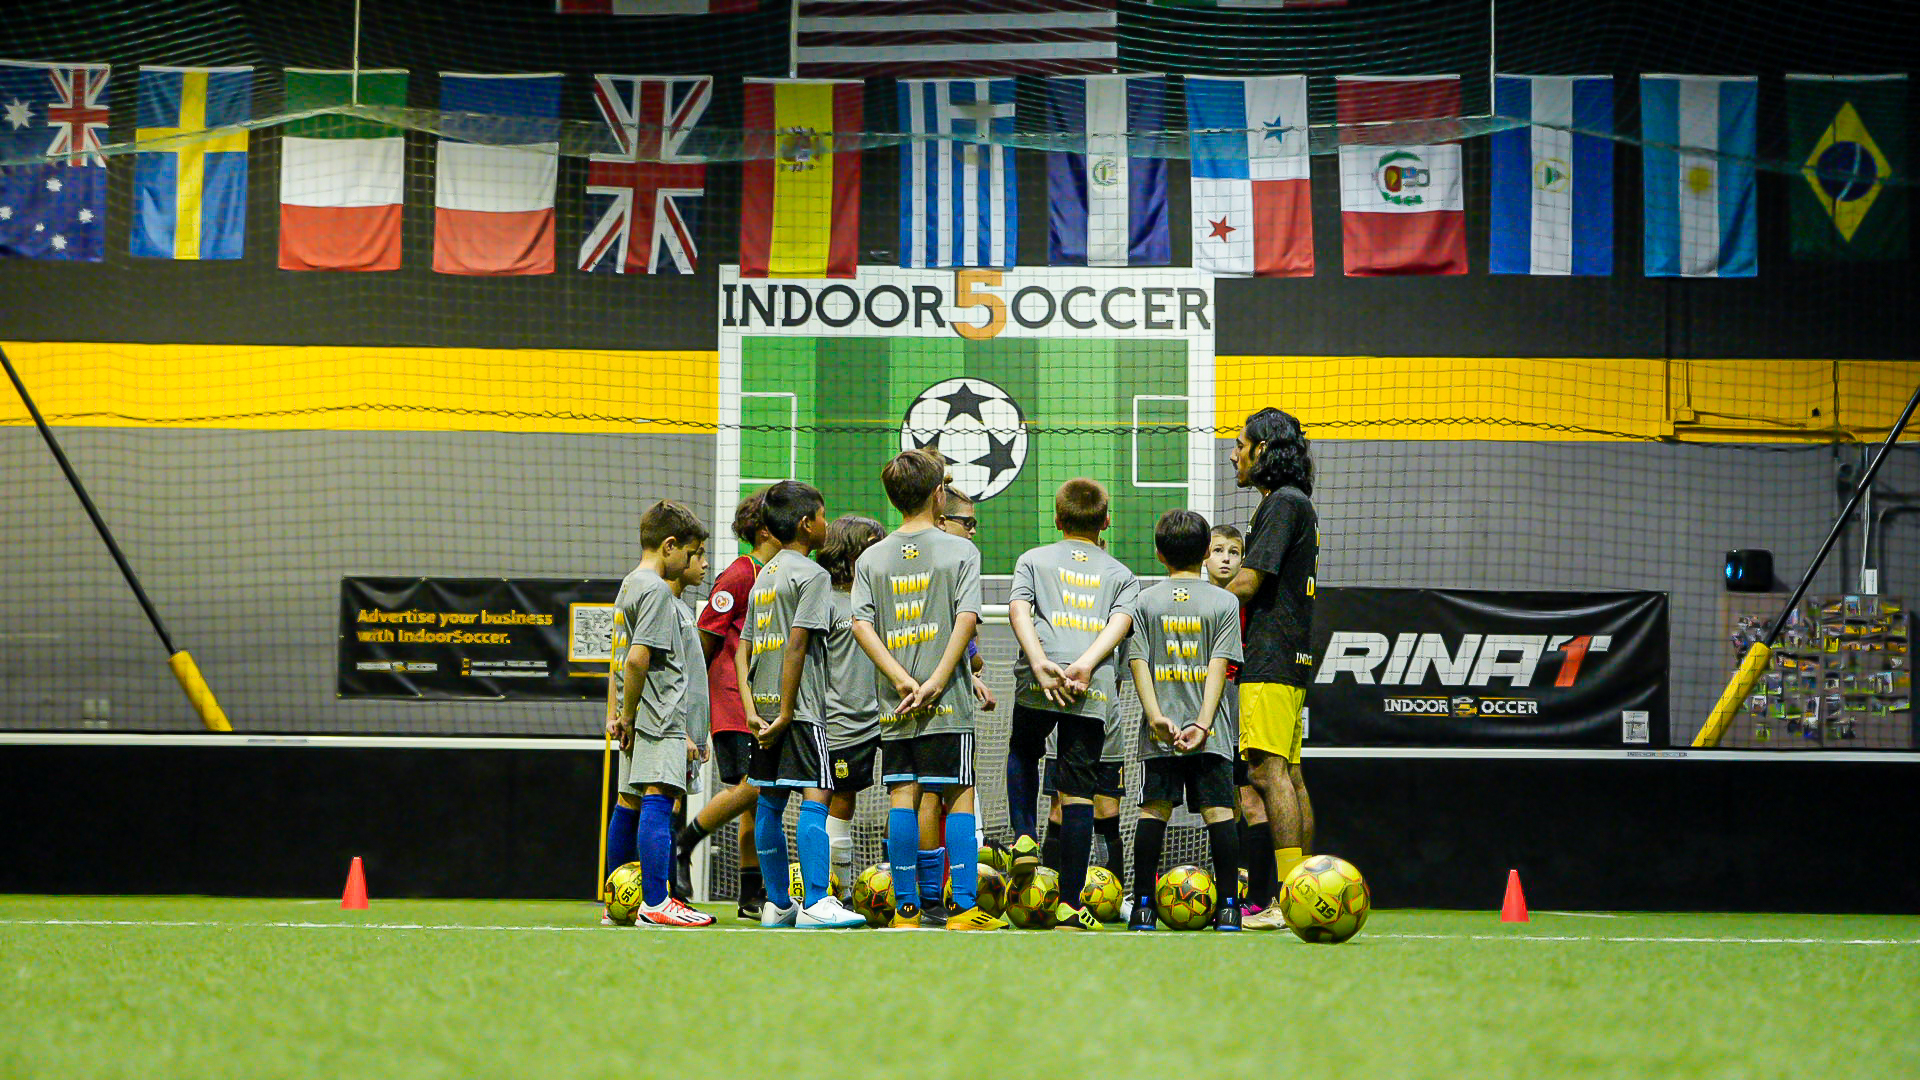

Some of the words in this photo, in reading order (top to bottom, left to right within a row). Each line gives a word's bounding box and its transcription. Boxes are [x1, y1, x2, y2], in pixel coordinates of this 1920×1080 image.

[890, 571, 931, 595] TRAIN
[1058, 566, 1101, 588] TRAIN
[1062, 589, 1095, 609] PLAY
[357, 608, 437, 624] Advertise
[439, 612, 479, 628] your
[481, 609, 553, 626] business
[895, 599, 926, 622] PLAY
[1160, 615, 1202, 634] TRAIN
[357, 628, 395, 642] with
[398, 628, 511, 644] IndoorSoccer.
[886, 622, 939, 651] DEVELOP
[1165, 639, 1199, 658] PLAY
[1383, 698, 1449, 713] INDOOR
